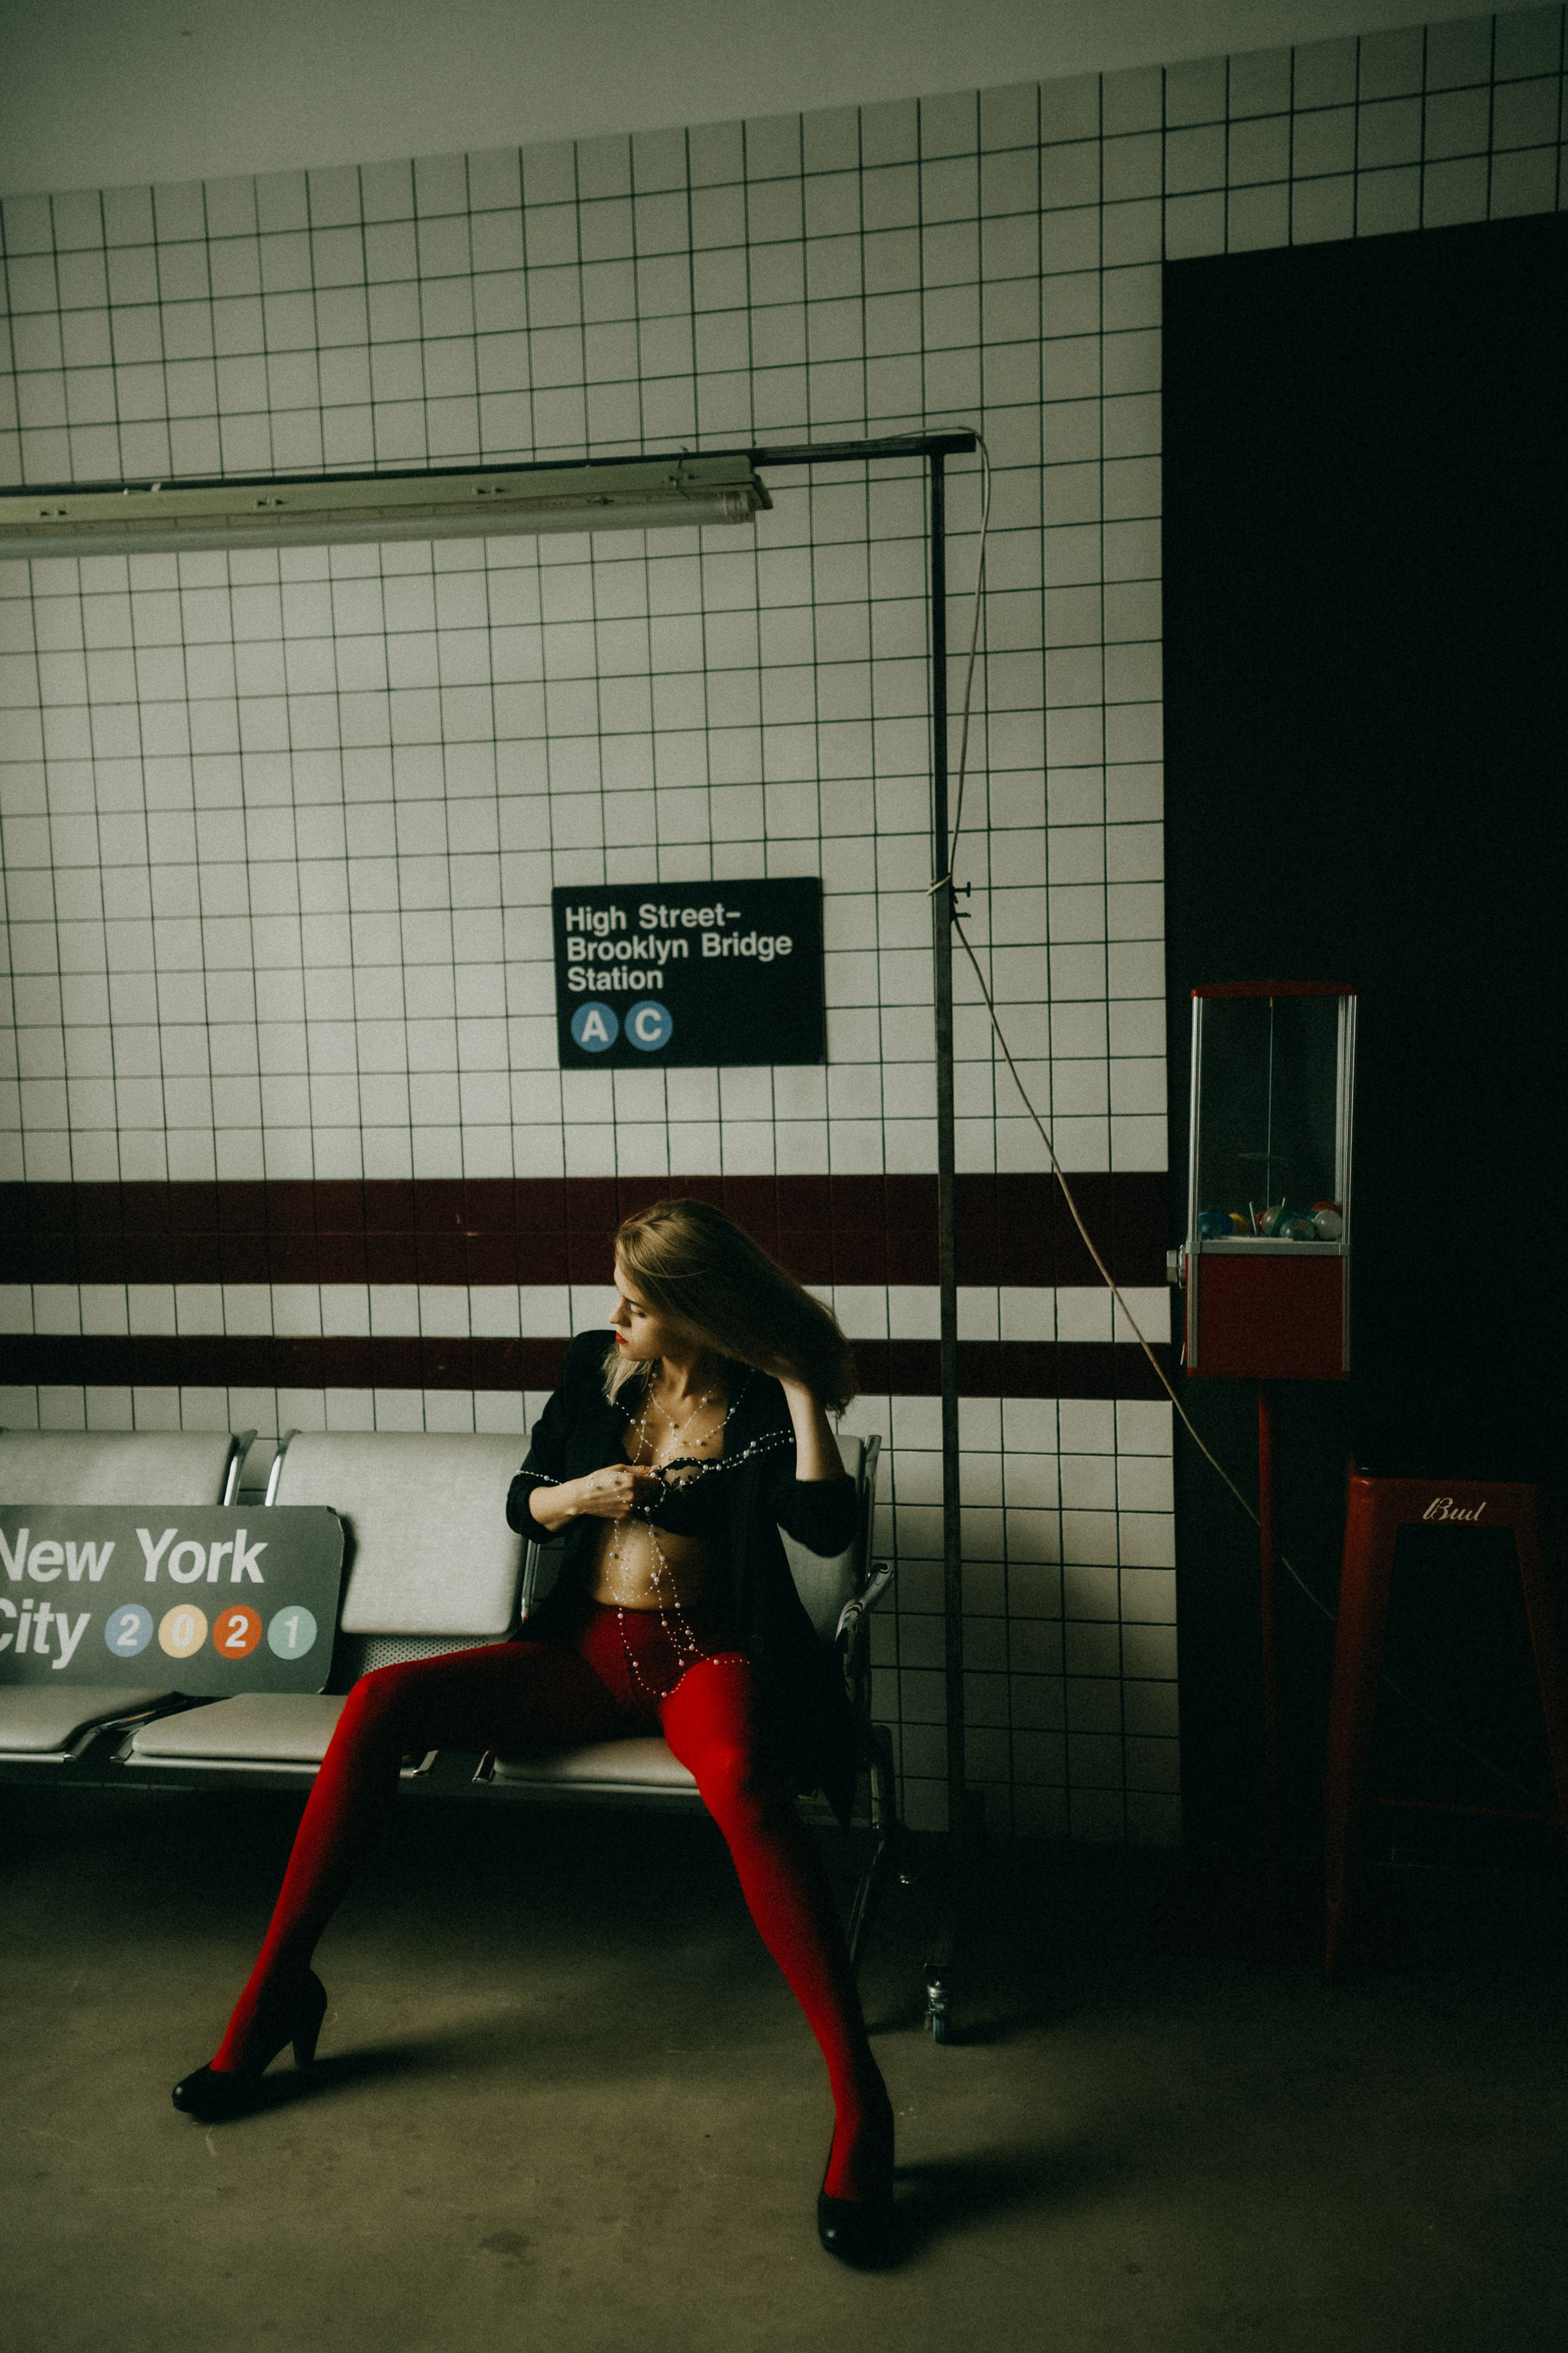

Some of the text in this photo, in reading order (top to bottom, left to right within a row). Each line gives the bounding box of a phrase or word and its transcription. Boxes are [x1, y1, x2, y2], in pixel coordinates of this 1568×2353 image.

[565, 903, 741, 937] High Street-
[567, 931, 793, 964] Brooklyn Bridge
[567, 966, 663, 992] Station
[581, 1008, 662, 1043] A C
[1422, 1497, 1487, 1520] Bud
[0, 1528, 268, 1584] New York
